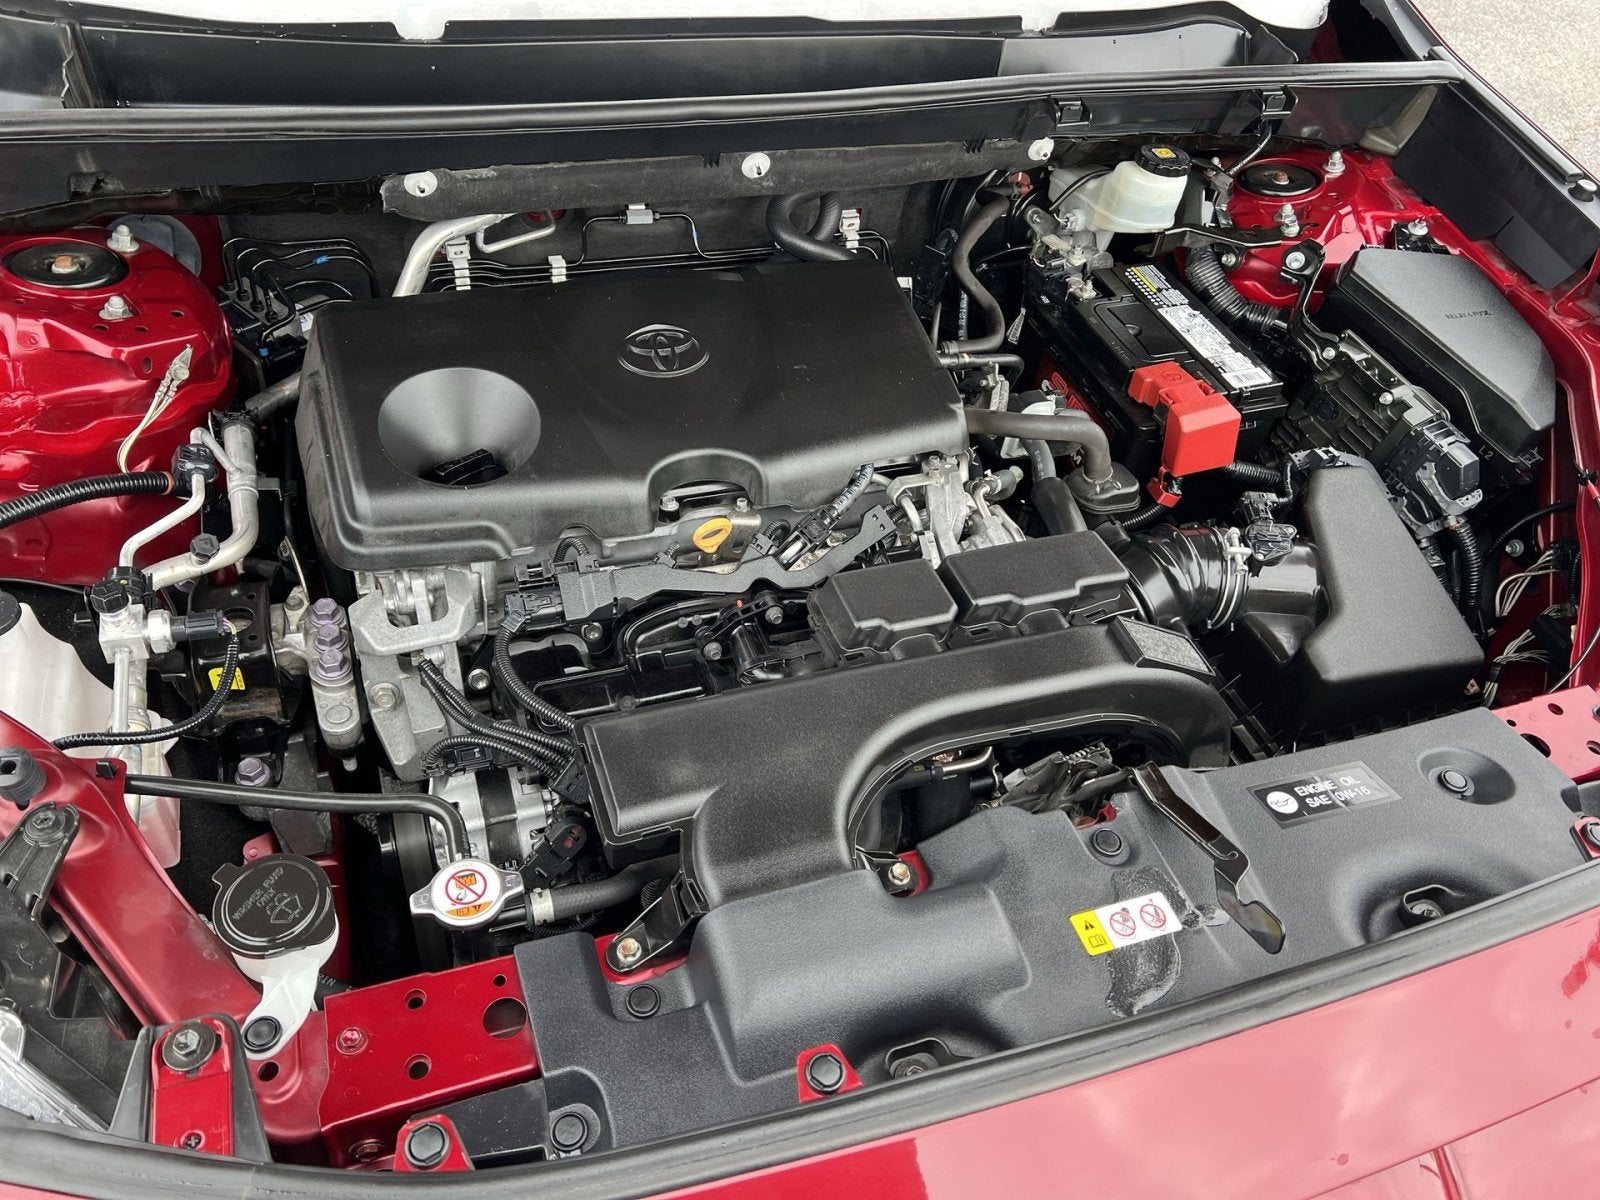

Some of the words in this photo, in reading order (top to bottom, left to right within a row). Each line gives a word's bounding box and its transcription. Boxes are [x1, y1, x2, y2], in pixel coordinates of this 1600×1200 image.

[1294, 780, 1338, 797] ENGINE
[1339, 775, 1361, 787] OIL
[1305, 794, 1333, 808] SAE
[1334, 785, 1371, 802] 0W-16
